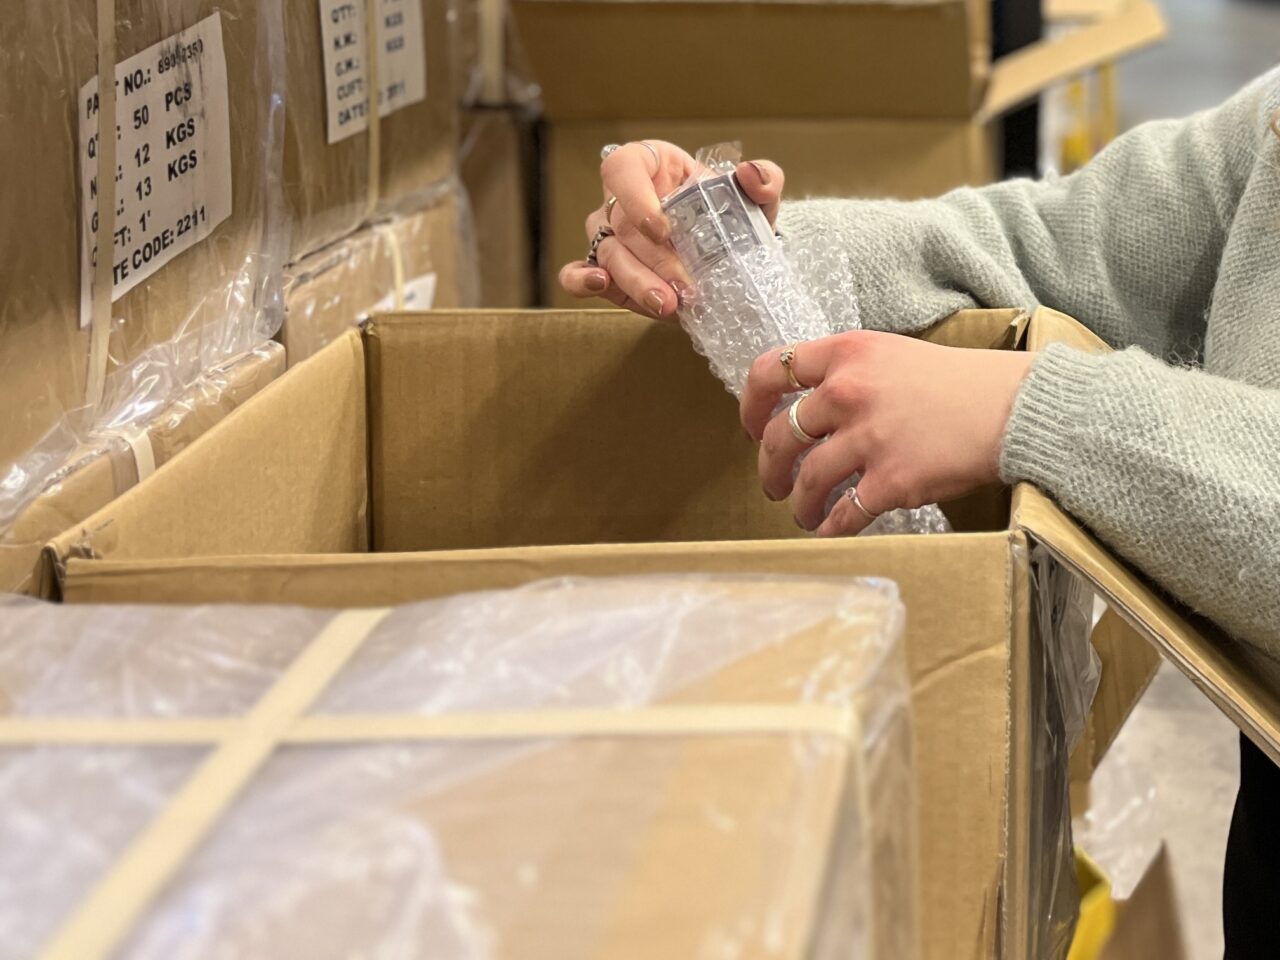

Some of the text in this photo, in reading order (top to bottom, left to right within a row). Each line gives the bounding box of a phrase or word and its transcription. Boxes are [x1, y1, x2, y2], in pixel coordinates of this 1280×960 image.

[124, 68, 151, 96] NO.:
[133, 105, 149, 130] 50
[165, 82, 192, 112] PCS
[134, 143, 151, 168] 12
[166, 118, 195, 150] KGS
[136, 176, 152, 201] 13
[167, 149, 198, 182] KGS
[132, 229, 174, 270] CODE:
[176, 205, 205, 238] 2211
